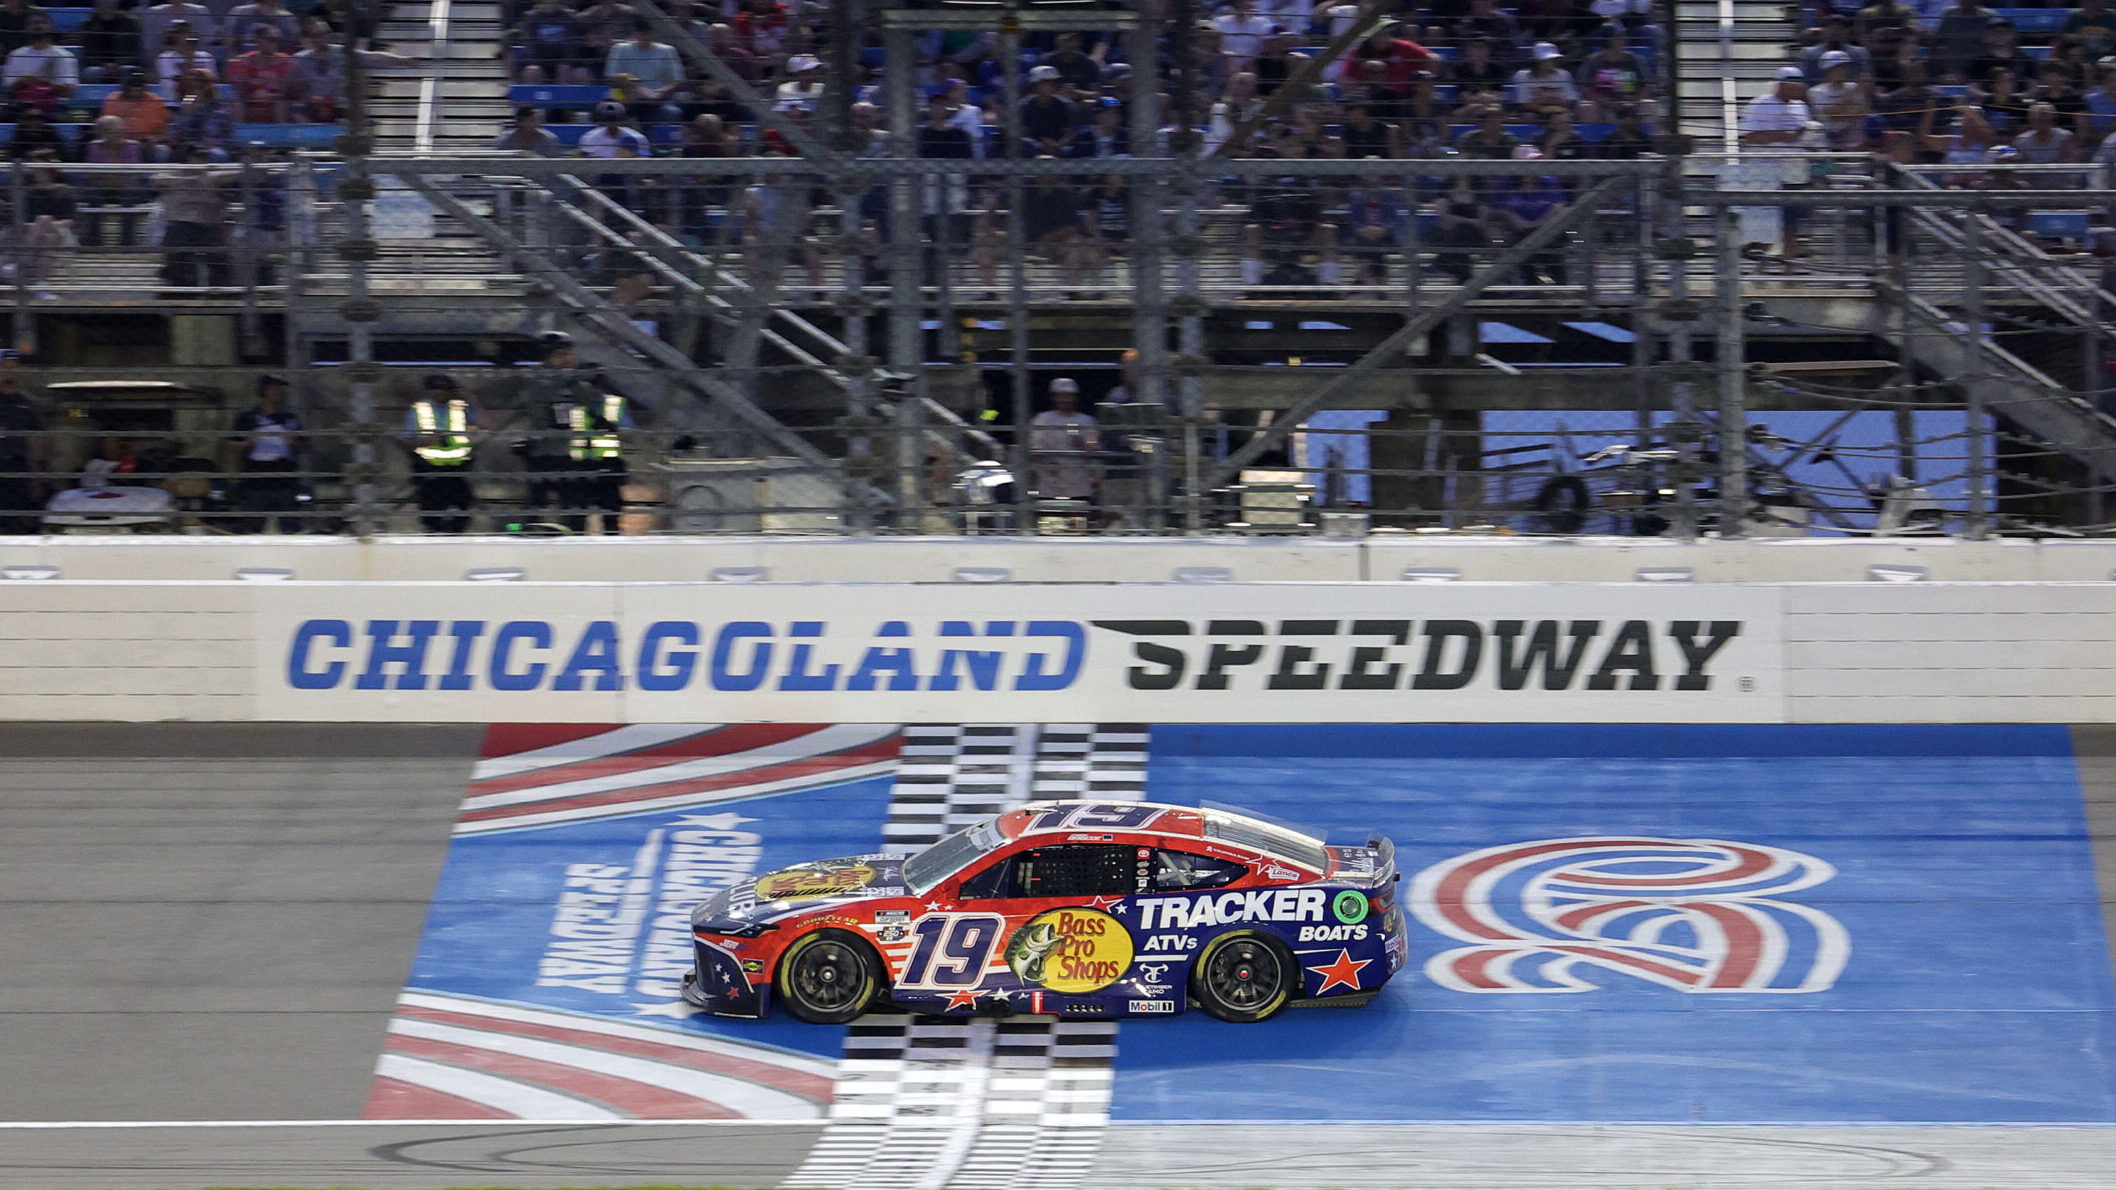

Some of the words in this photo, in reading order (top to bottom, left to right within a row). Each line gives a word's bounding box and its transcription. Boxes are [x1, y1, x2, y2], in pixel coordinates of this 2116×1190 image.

[284, 618, 1087, 692] CHICAGOLAND
[1087, 618, 1745, 692] SPEEDWAY
[1271, 868, 1298, 879] Lance
[534, 829, 668, 994] SPEEDWAY
[1136, 888, 1326, 930] TRACKER
[796, 915, 858, 928] GOODYEAR
[1056, 911, 1106, 936] Bass
[1298, 924, 1369, 942] BOATS
[899, 914, 1003, 987] 19
[1057, 934, 1095, 957] Pro
[1143, 934, 1198, 951] ATVs
[1058, 956, 1119, 984] Shops
[1131, 1002, 1160, 1011] Mobil
